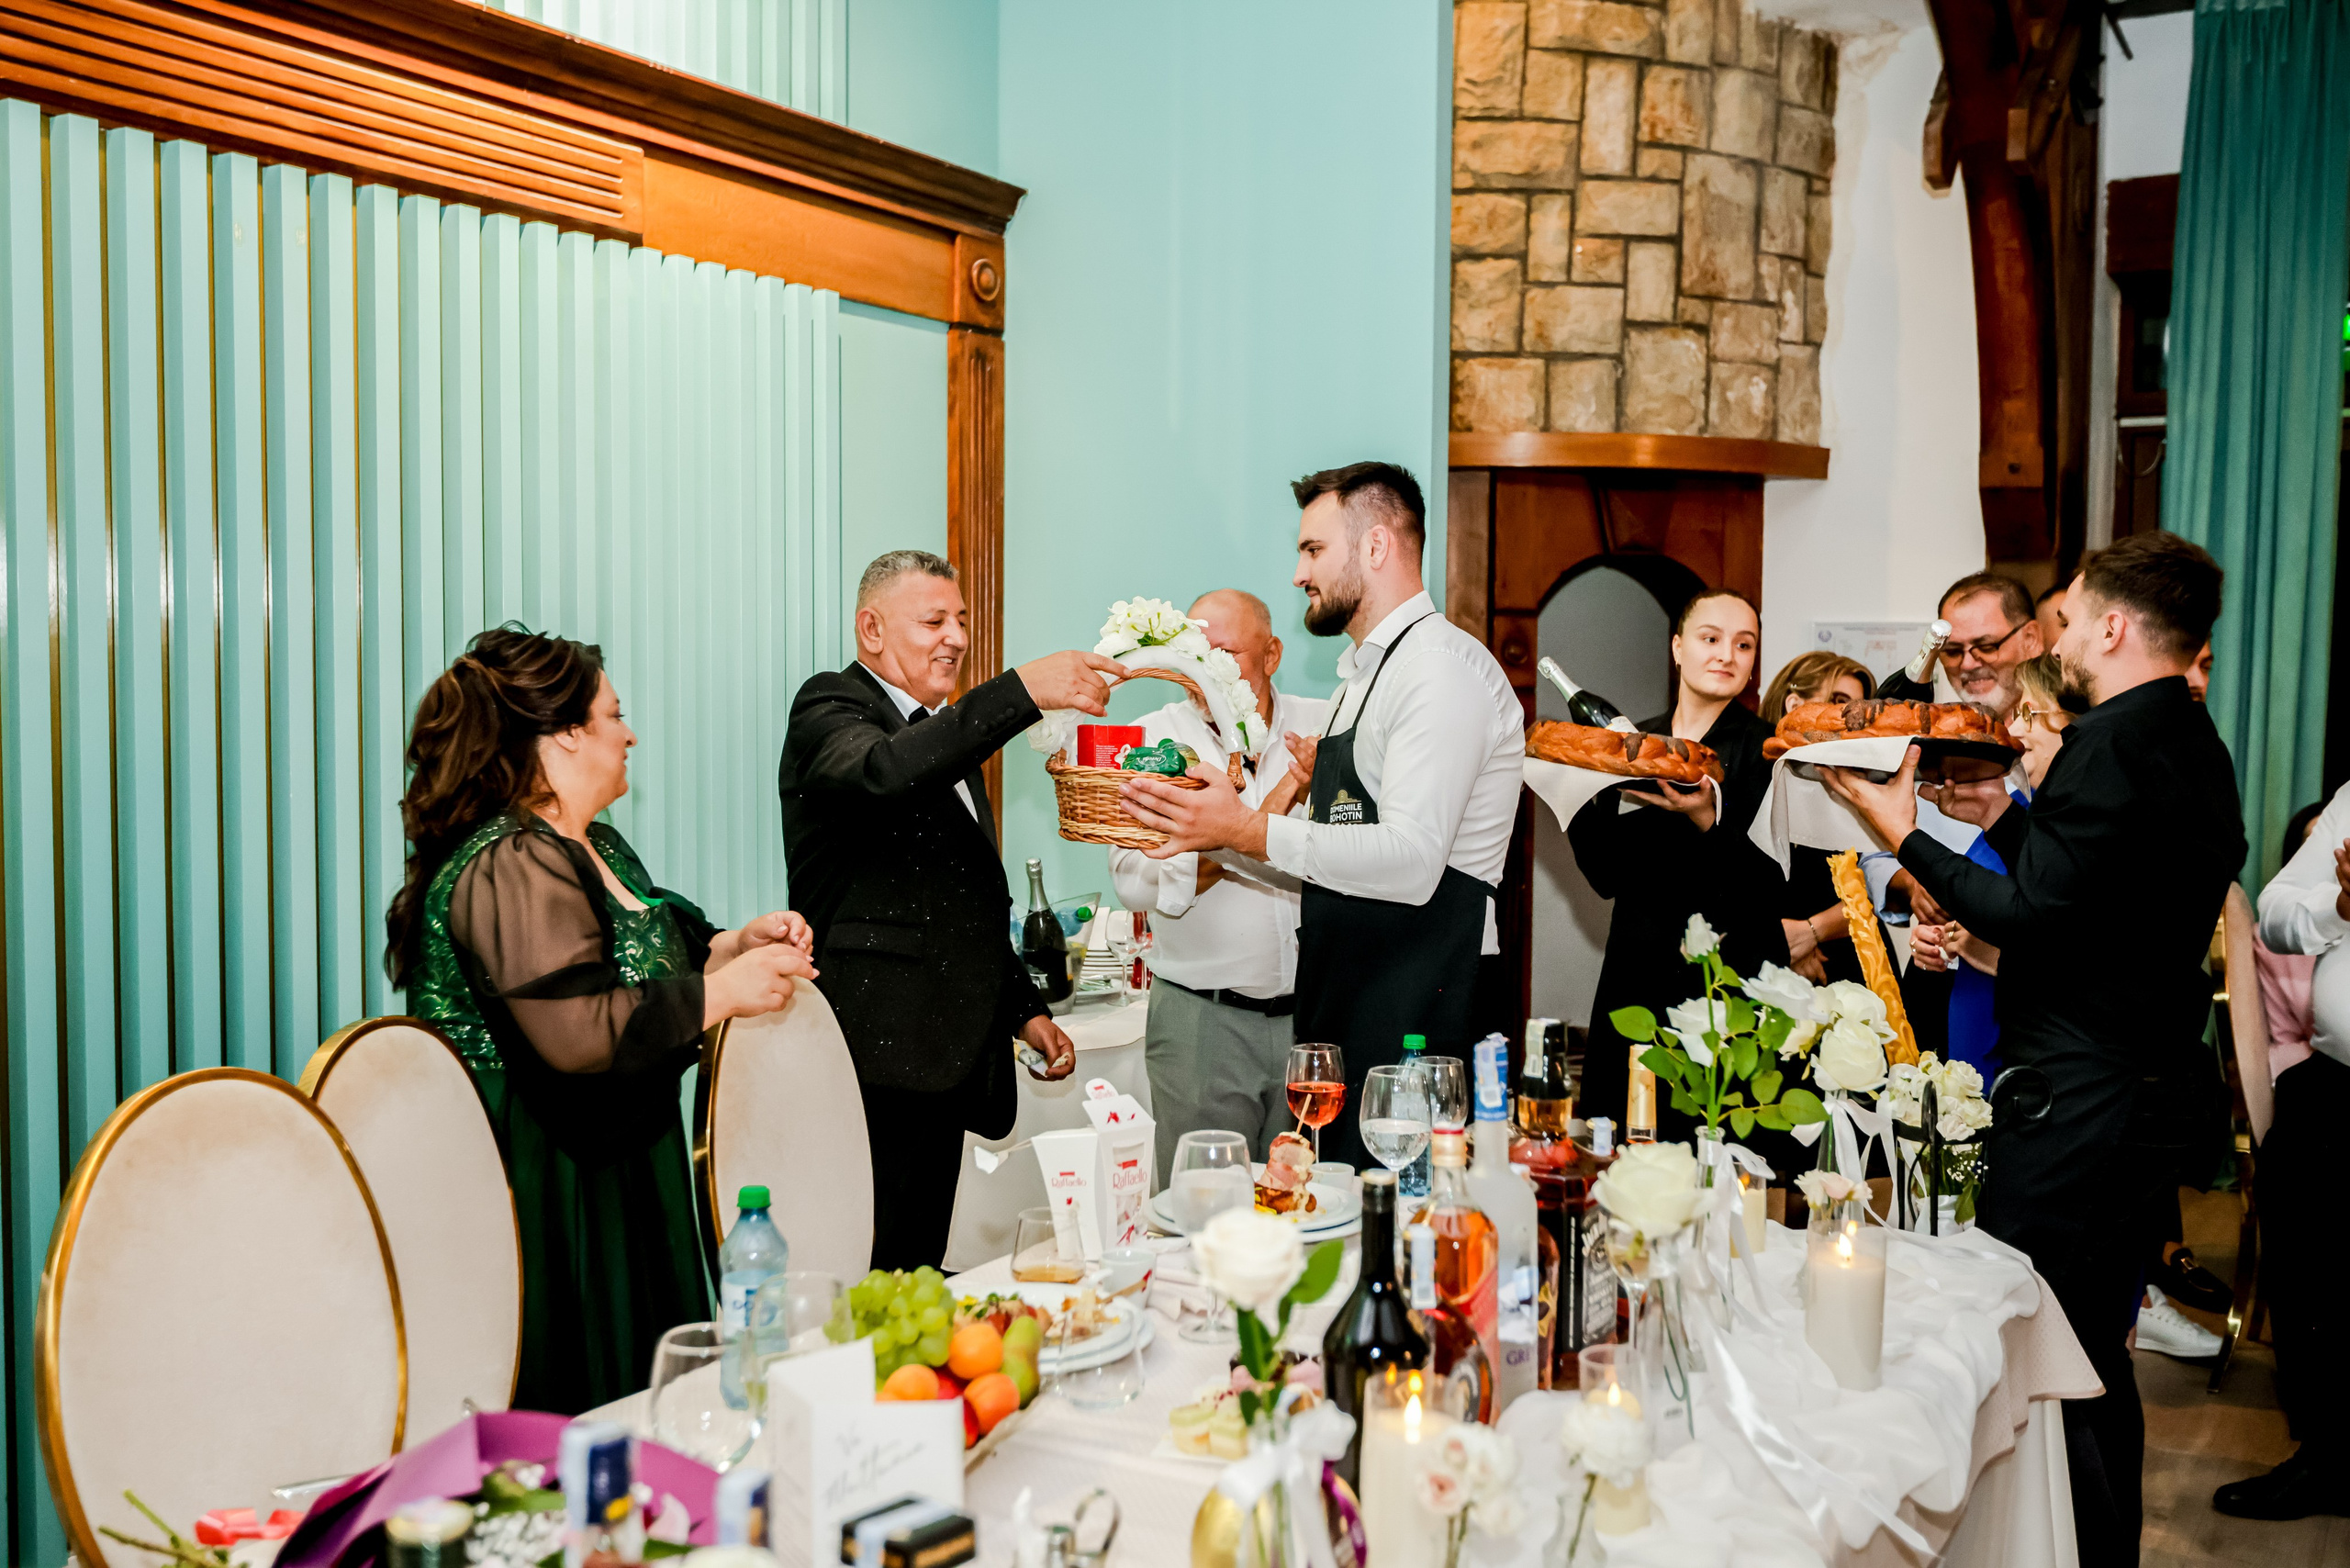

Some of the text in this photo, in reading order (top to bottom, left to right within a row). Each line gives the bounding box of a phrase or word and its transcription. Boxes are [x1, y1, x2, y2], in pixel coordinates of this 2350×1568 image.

[1330, 803, 1362, 814] DOMENIILE
[1330, 812, 1362, 823] BOHOTIN
[1051, 1177, 1087, 1189] Raffaello
[1113, 1168, 1147, 1189] Raffaello
